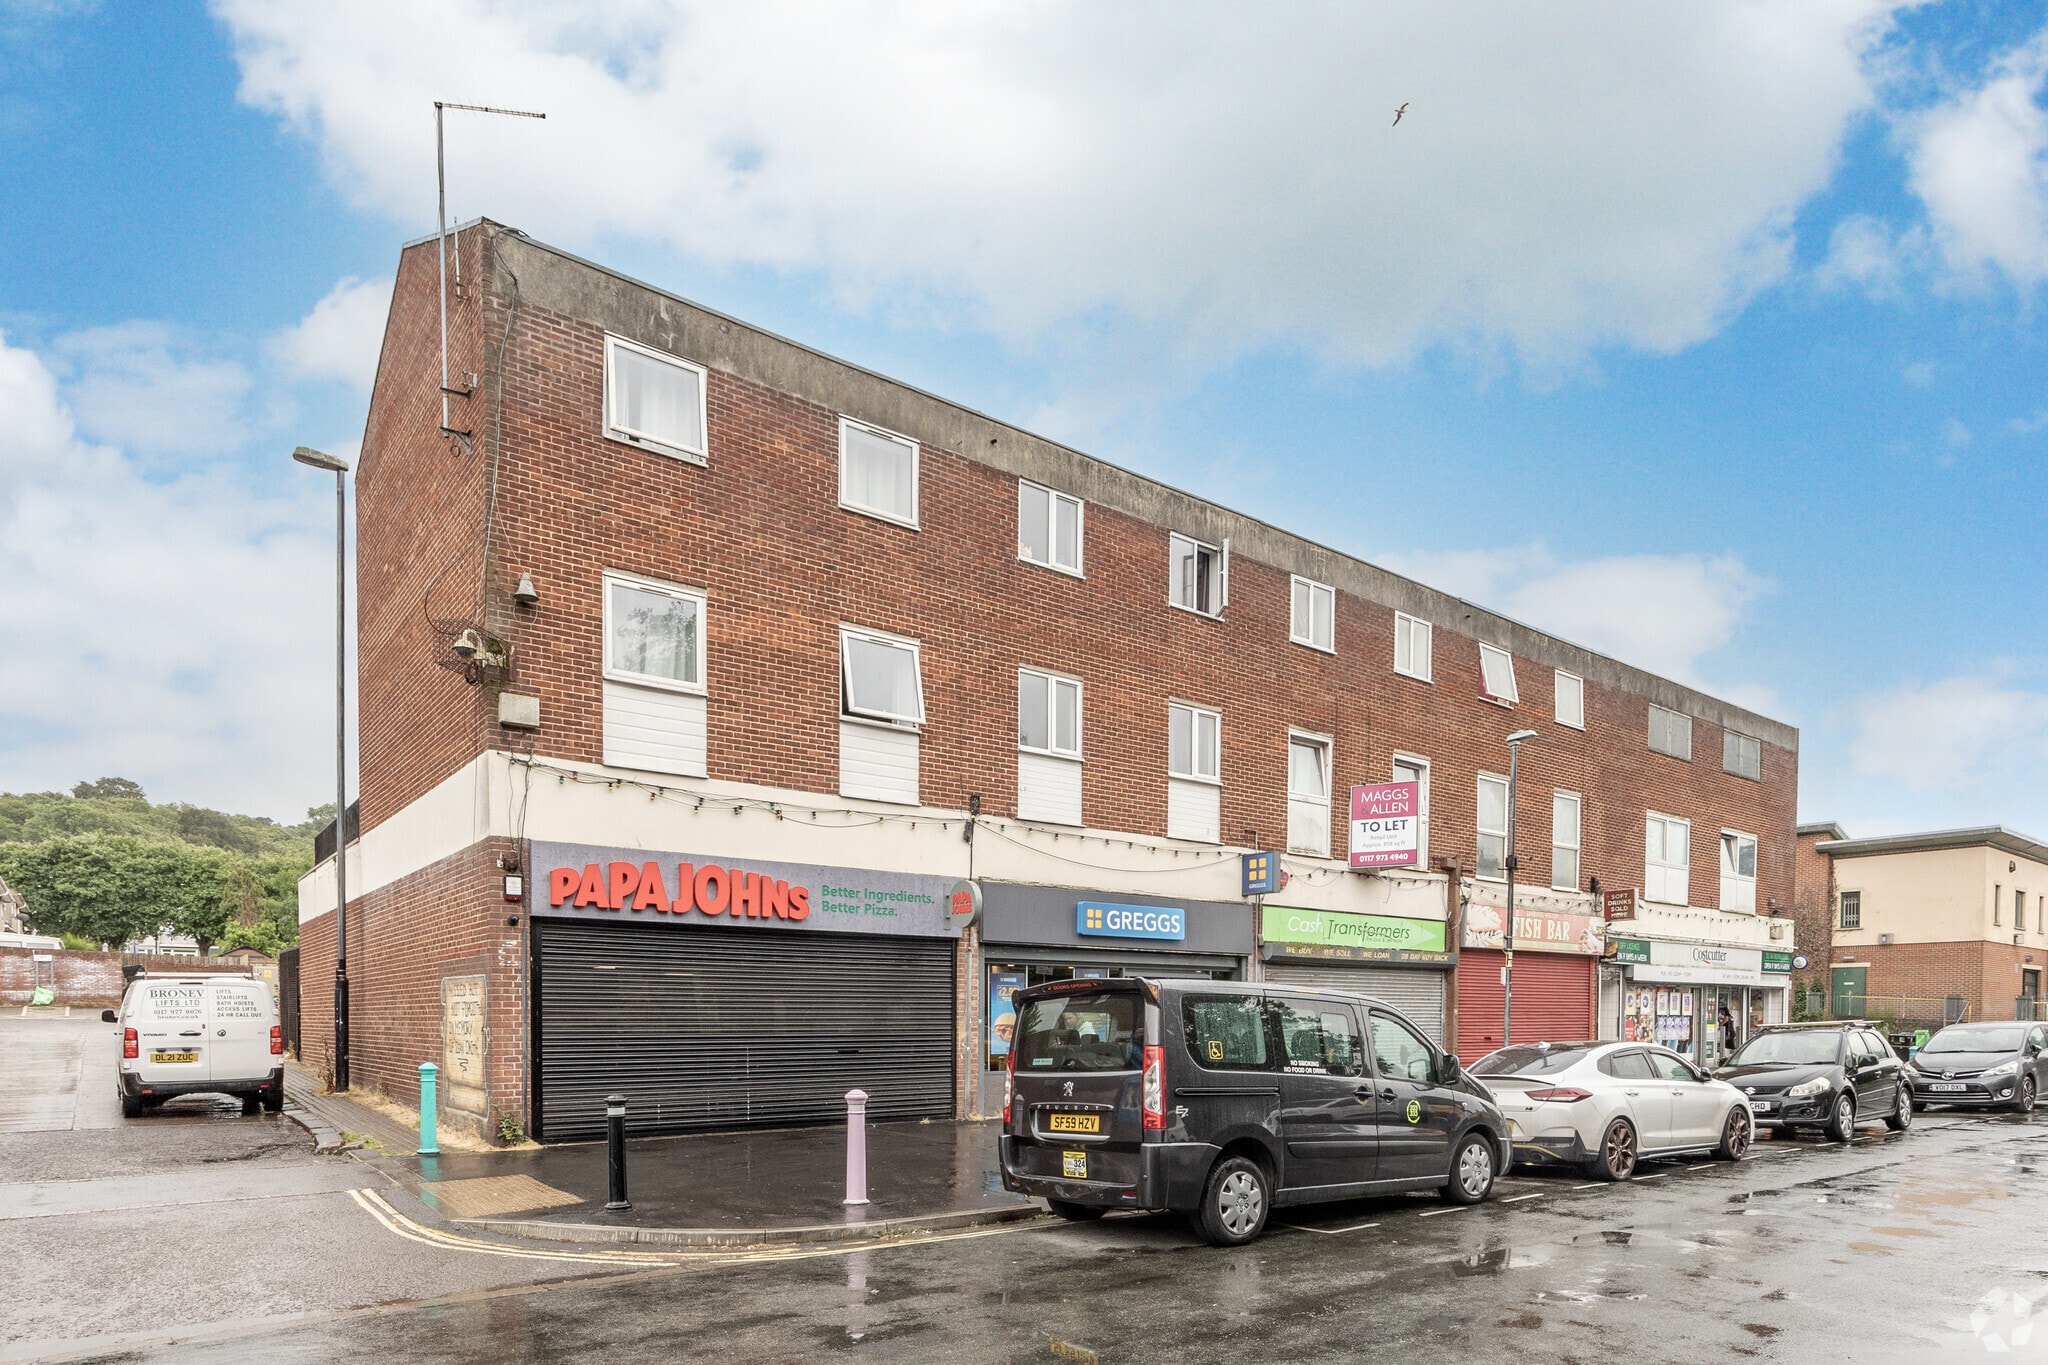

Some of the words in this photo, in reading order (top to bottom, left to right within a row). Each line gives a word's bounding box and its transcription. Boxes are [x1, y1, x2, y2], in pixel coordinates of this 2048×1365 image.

[1361, 788, 1409, 802] MAGGS
[1370, 802, 1409, 815] ALLEN
[1360, 821, 1381, 833] TO
[1384, 819, 1408, 831] LET
[549, 861, 671, 912] PAPA
[671, 862, 811, 921] JOHNS
[821, 884, 861, 899] Better
[864, 888, 935, 905] Ingredients.
[952, 890, 972, 904] PAPA
[821, 901, 861, 914] Better
[864, 903, 898, 916] Pizza.
[952, 903, 973, 914] JOHNS
[1106, 910, 1181, 933] GREGGS
[1287, 911, 1324, 933] Cash
[1327, 919, 1411, 942] Transformers
[1512, 916, 1542, 939] FISH
[1547, 919, 1571, 941] BAR
[1285, 946, 1296, 954] WE
[1692, 947, 1727, 962] Costcutter
[177, 1053, 194, 1061] ZUC
[1054, 1116, 1076, 1129] SF59
[1078, 1117, 1096, 1130] HZV
[1073, 1159, 1086, 1168] 324
